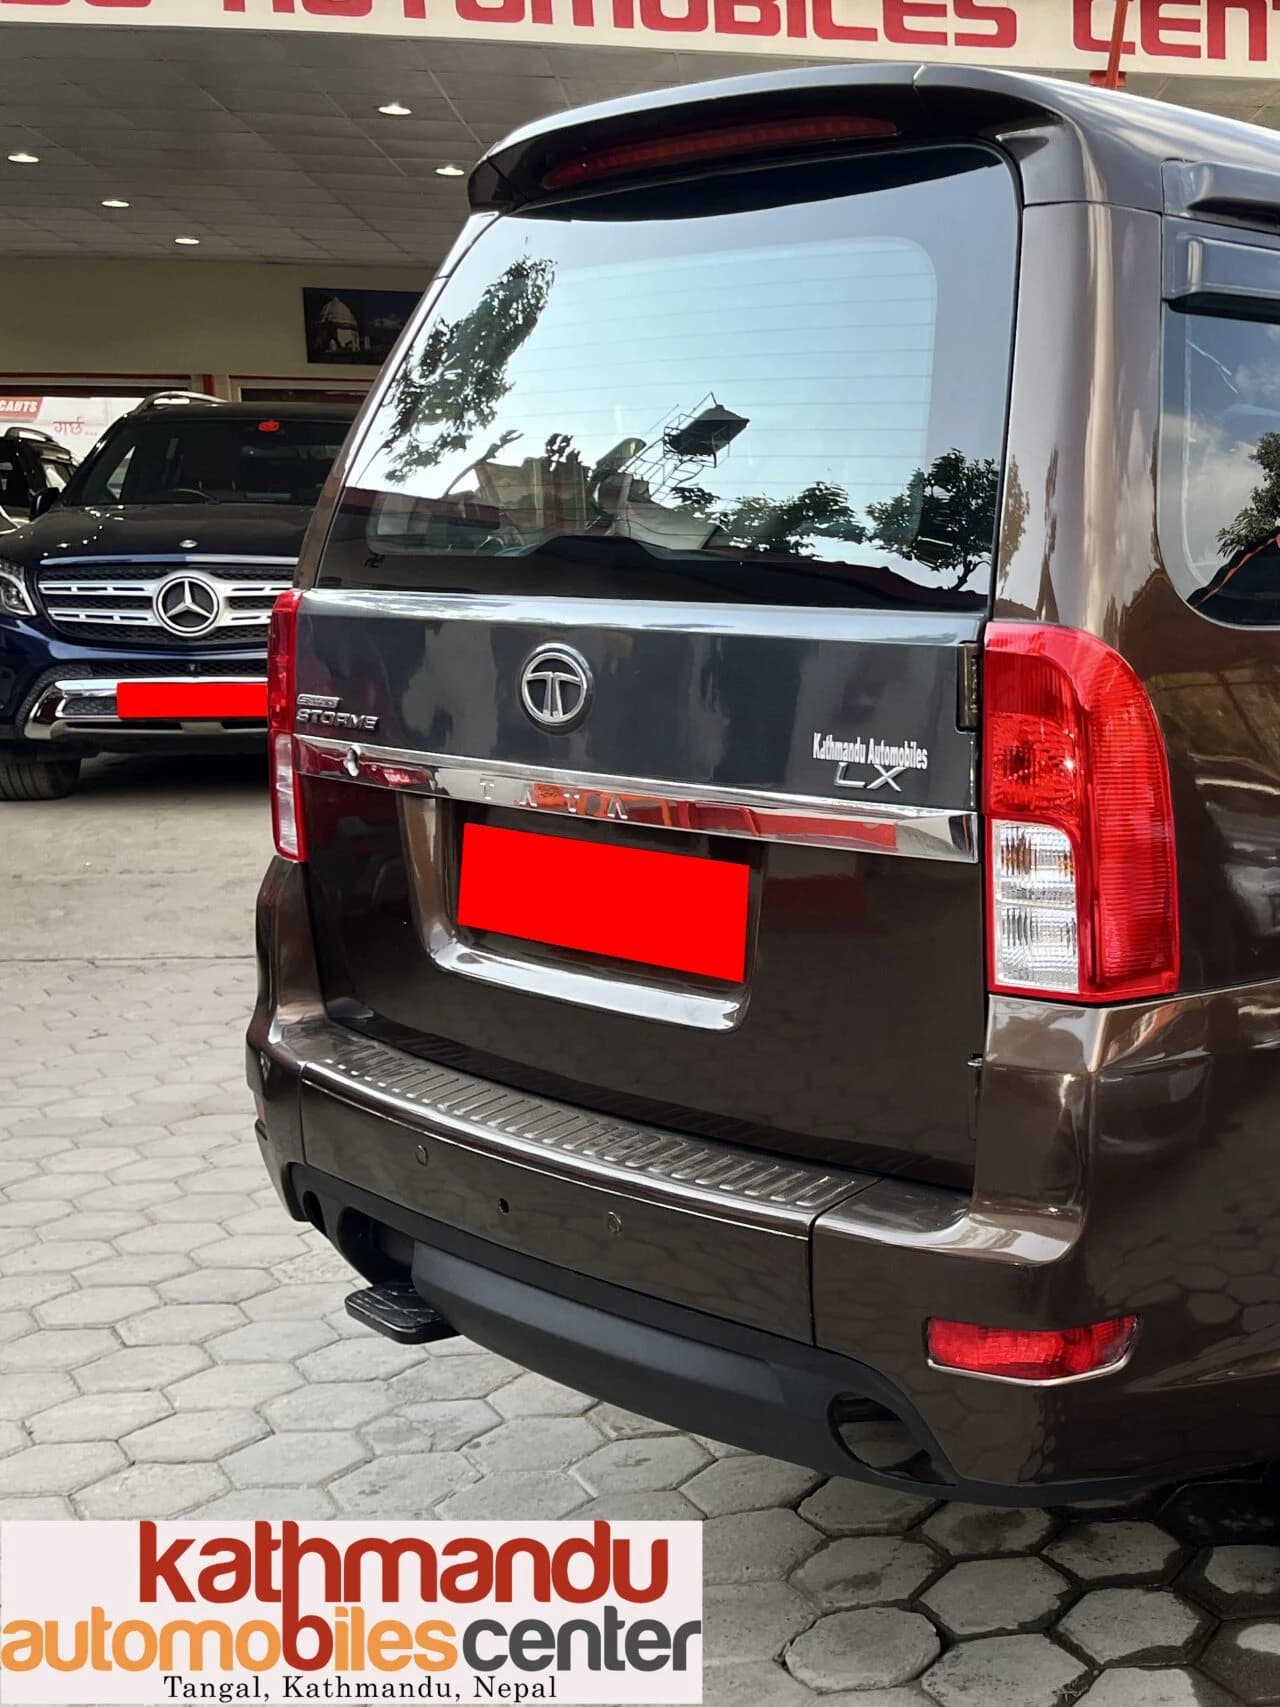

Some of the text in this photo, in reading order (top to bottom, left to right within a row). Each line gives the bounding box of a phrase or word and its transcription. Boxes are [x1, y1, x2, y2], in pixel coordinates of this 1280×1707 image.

[223, 0, 1017, 49] OBILES
[296, 708, 380, 729] STORME
[813, 732, 928, 770] Kathmandu Automobiles
[834, 761, 903, 792] LX
